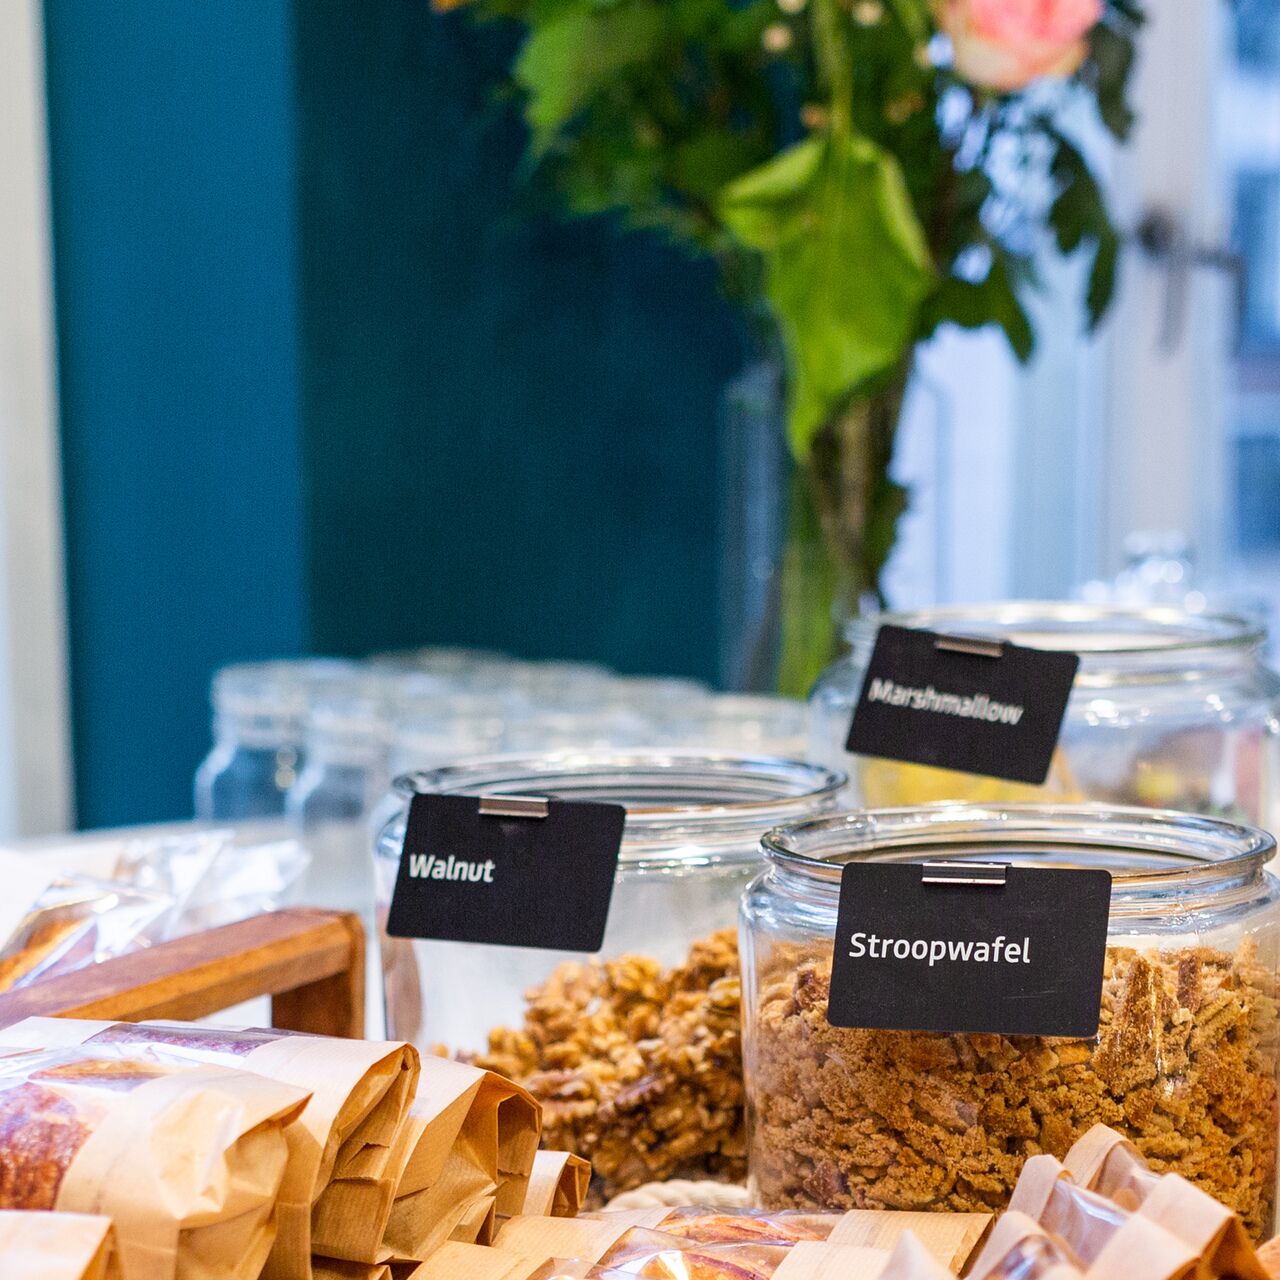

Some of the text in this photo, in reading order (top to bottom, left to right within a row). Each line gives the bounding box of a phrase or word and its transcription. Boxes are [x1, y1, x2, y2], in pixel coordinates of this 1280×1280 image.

[869, 678, 1024, 725] Marshmallow
[409, 853, 495, 882] Walnut
[849, 932, 1030, 966] Stroopwafel
